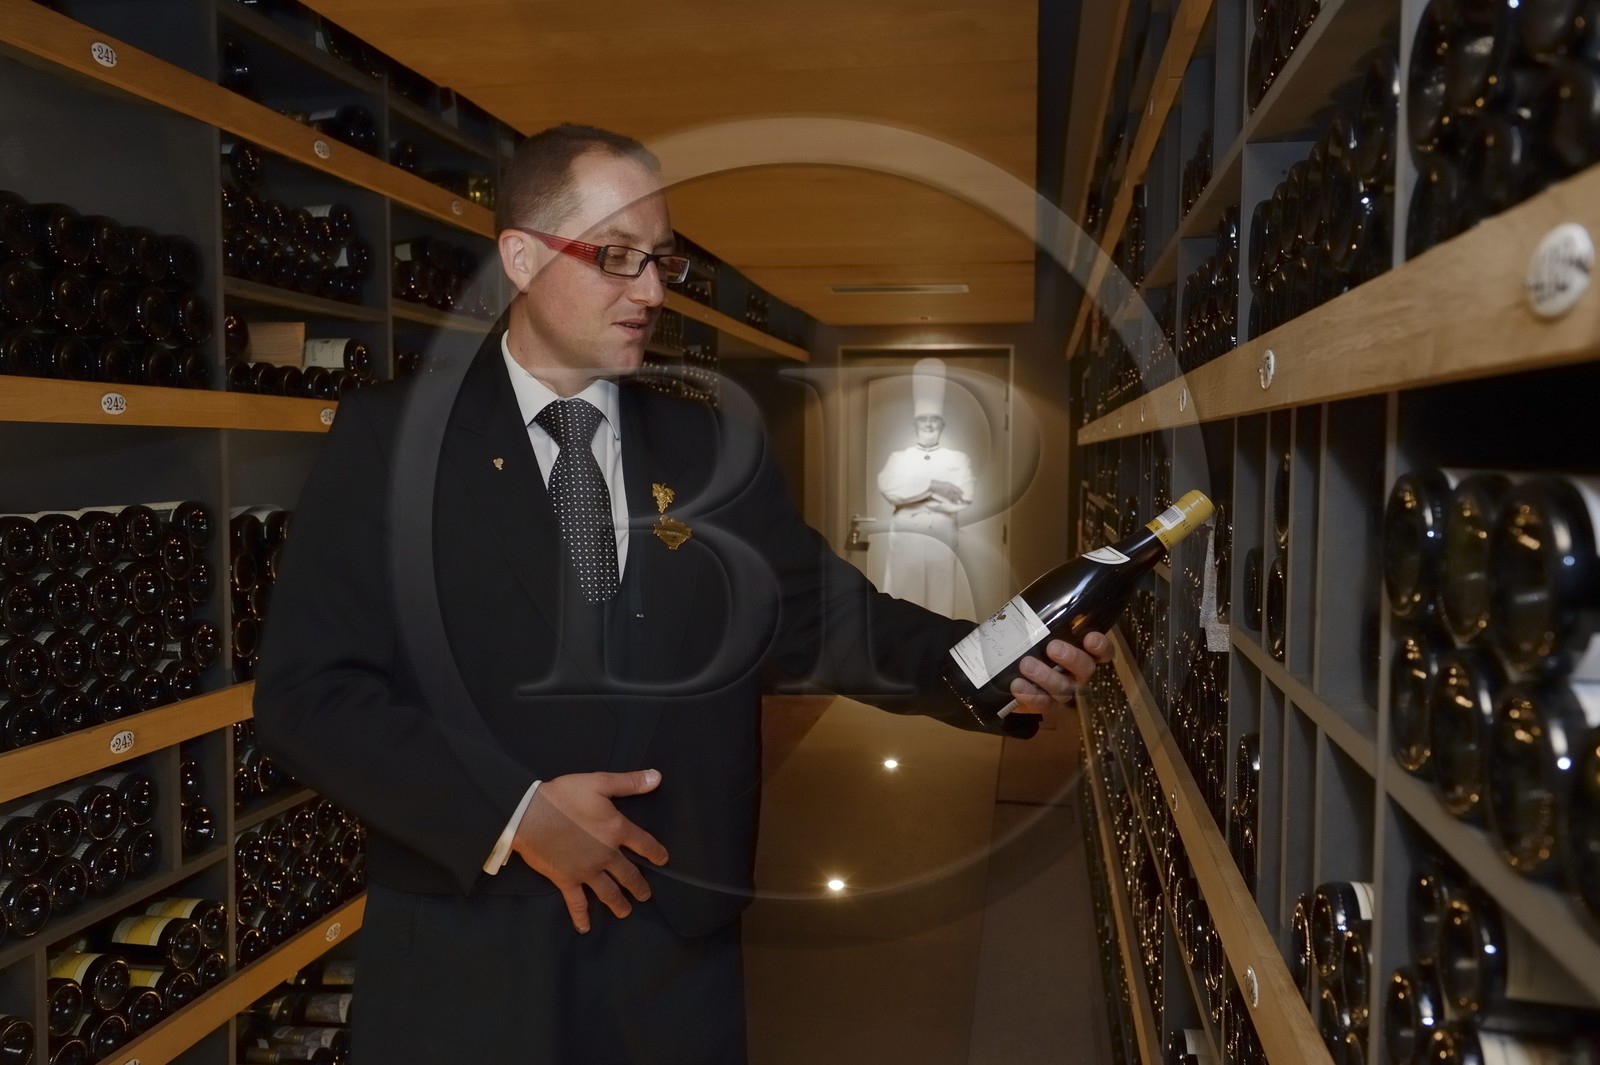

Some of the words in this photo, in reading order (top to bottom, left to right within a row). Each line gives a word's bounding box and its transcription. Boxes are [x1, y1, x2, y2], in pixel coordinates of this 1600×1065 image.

[97, 45, 114, 65] 241
[106, 396, 125, 411] 242
[115, 732, 133, 752] 243
